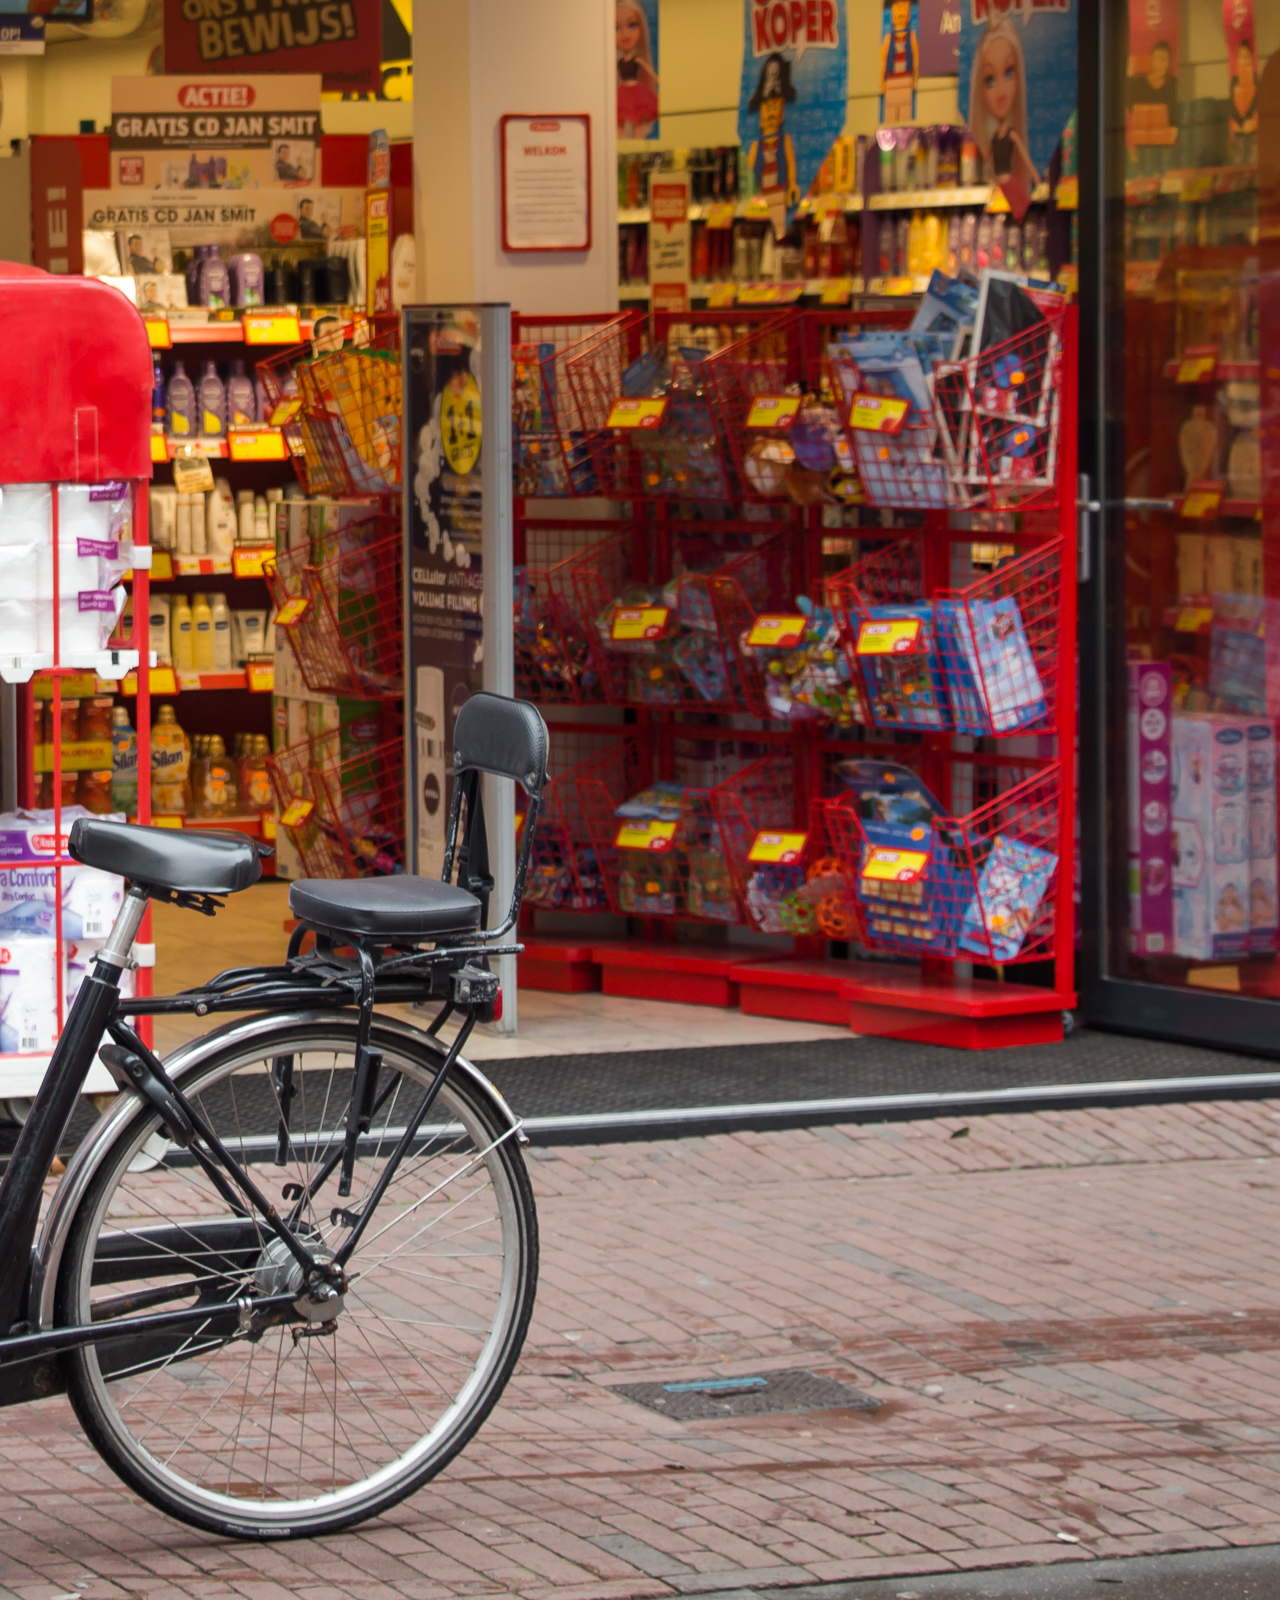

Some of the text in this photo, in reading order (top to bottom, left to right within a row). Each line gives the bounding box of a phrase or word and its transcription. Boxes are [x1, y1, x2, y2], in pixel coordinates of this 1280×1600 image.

[199, 3, 357, 61] BEWIJS!
[754, 4, 838, 51] KOPER
[184, 86, 249, 107] ACTIE!
[116, 115, 318, 137] GRATIS CD JAN SMIT
[523, 146, 567, 156] WELKOM
[93, 207, 257, 224] GRATIS CD JAN SMIT
[413, 591, 477, 613] VOLUME FILLING
[151, 750, 183, 769] Silan
[9, 868, 56, 888] Comfort
